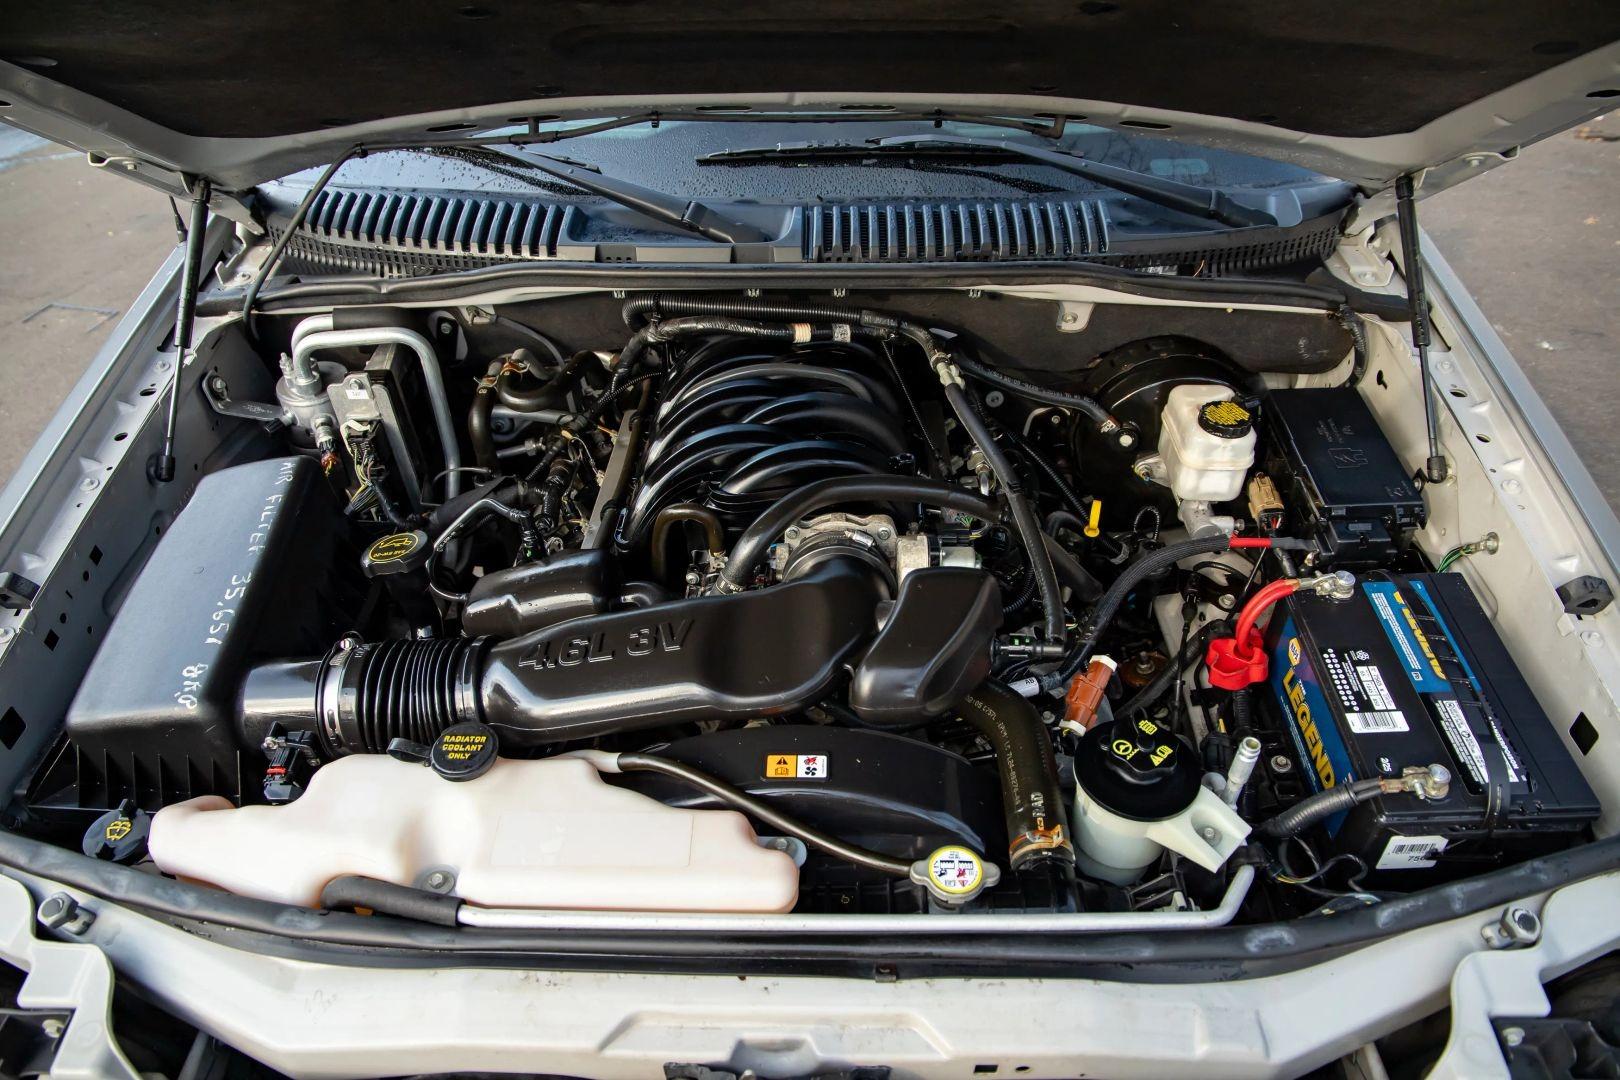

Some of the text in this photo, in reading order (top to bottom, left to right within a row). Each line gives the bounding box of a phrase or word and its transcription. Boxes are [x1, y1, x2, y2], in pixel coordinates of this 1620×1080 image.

[518, 619, 696, 670] 4.6L 3V
[443, 735, 487, 743] RADIATOR
[1282, 665, 1336, 790] LEGEND
[442, 743, 483, 751] COOLANT
